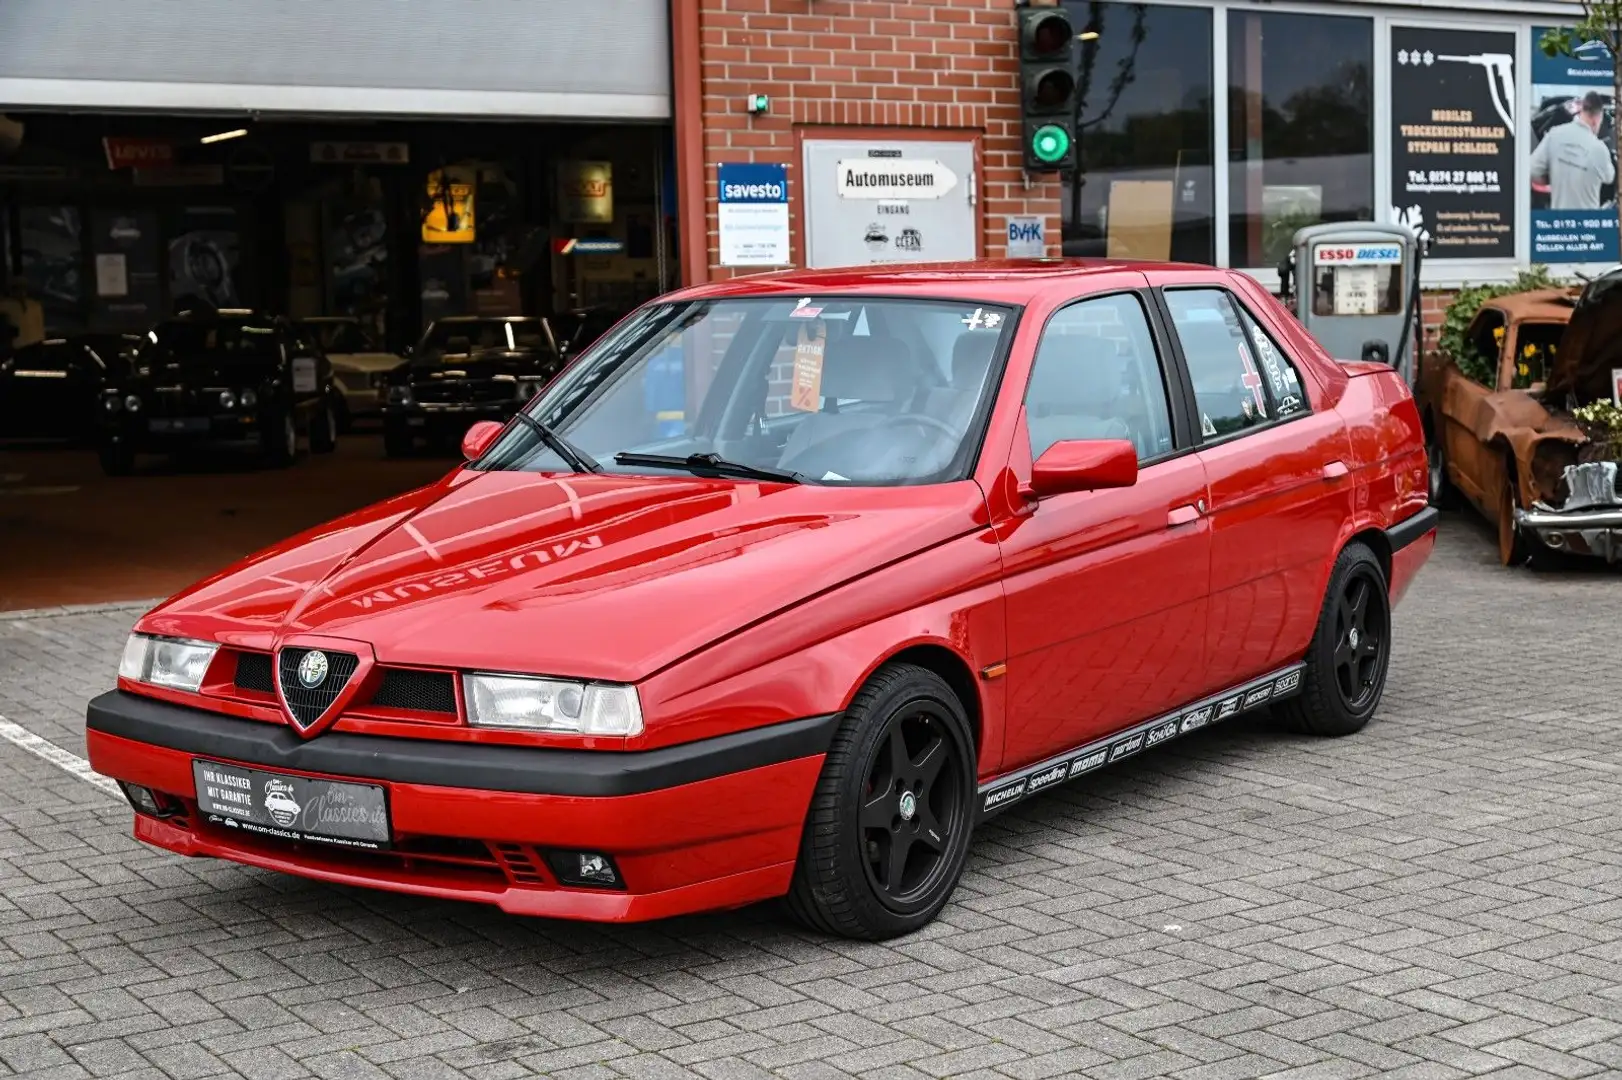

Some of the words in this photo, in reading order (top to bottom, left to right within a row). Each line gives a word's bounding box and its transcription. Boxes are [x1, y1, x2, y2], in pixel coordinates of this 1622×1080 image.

[846, 169, 934, 187] Automuseum
[877, 204, 909, 215] EINGANG
[1320, 249, 1354, 260] ESSO
[1356, 249, 1399, 259] DIESEL
[203, 770, 215, 782] IHR
[216, 772, 251, 790] KLASSIKER
[207, 786, 219, 798] MIT
[220, 789, 252, 806] GARANTIE
[985, 784, 1024, 806] MICHELIN
[242, 823, 300, 840] www.om-classics.de
